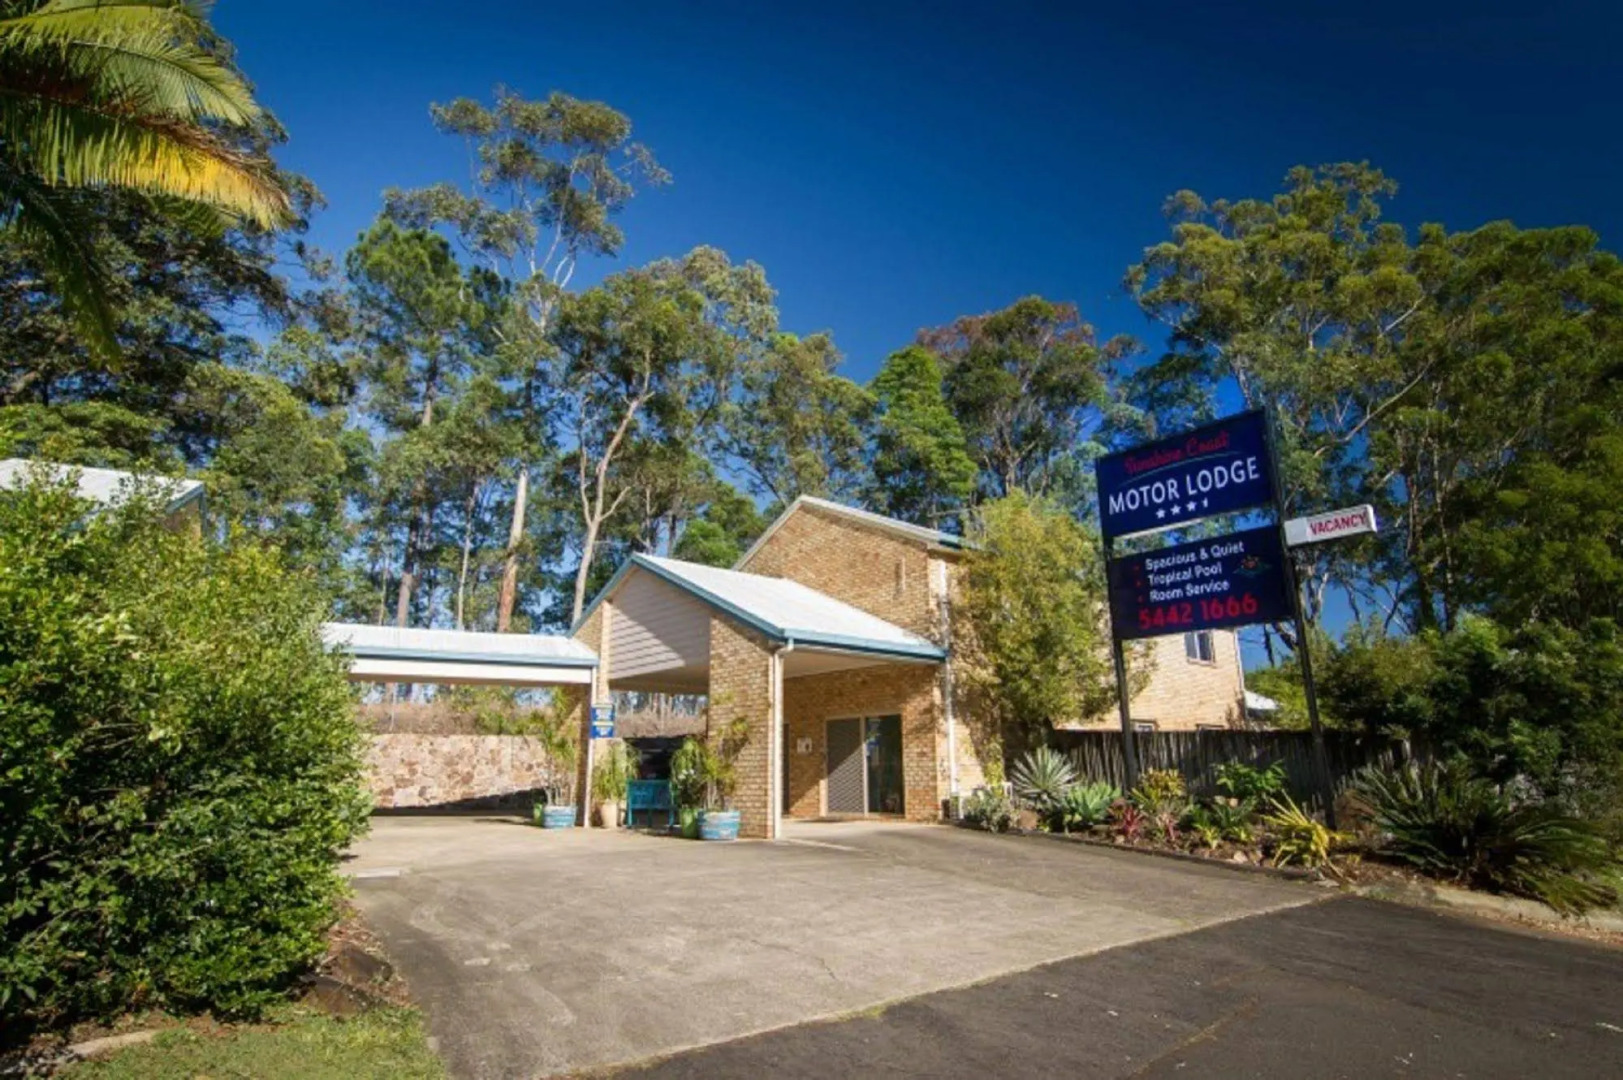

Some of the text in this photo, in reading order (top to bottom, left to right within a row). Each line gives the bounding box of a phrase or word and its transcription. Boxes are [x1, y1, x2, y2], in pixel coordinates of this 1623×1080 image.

[1109, 456, 1260, 515] MOTOR LODGE
[1310, 508, 1368, 536] VACANCY
[1145, 541, 1244, 572] Spacious & Quiet
[1148, 563, 1222, 586] Tropical Pool
[1150, 580, 1230, 603] Room Service
[1139, 592, 1258, 630] 5442 1666
